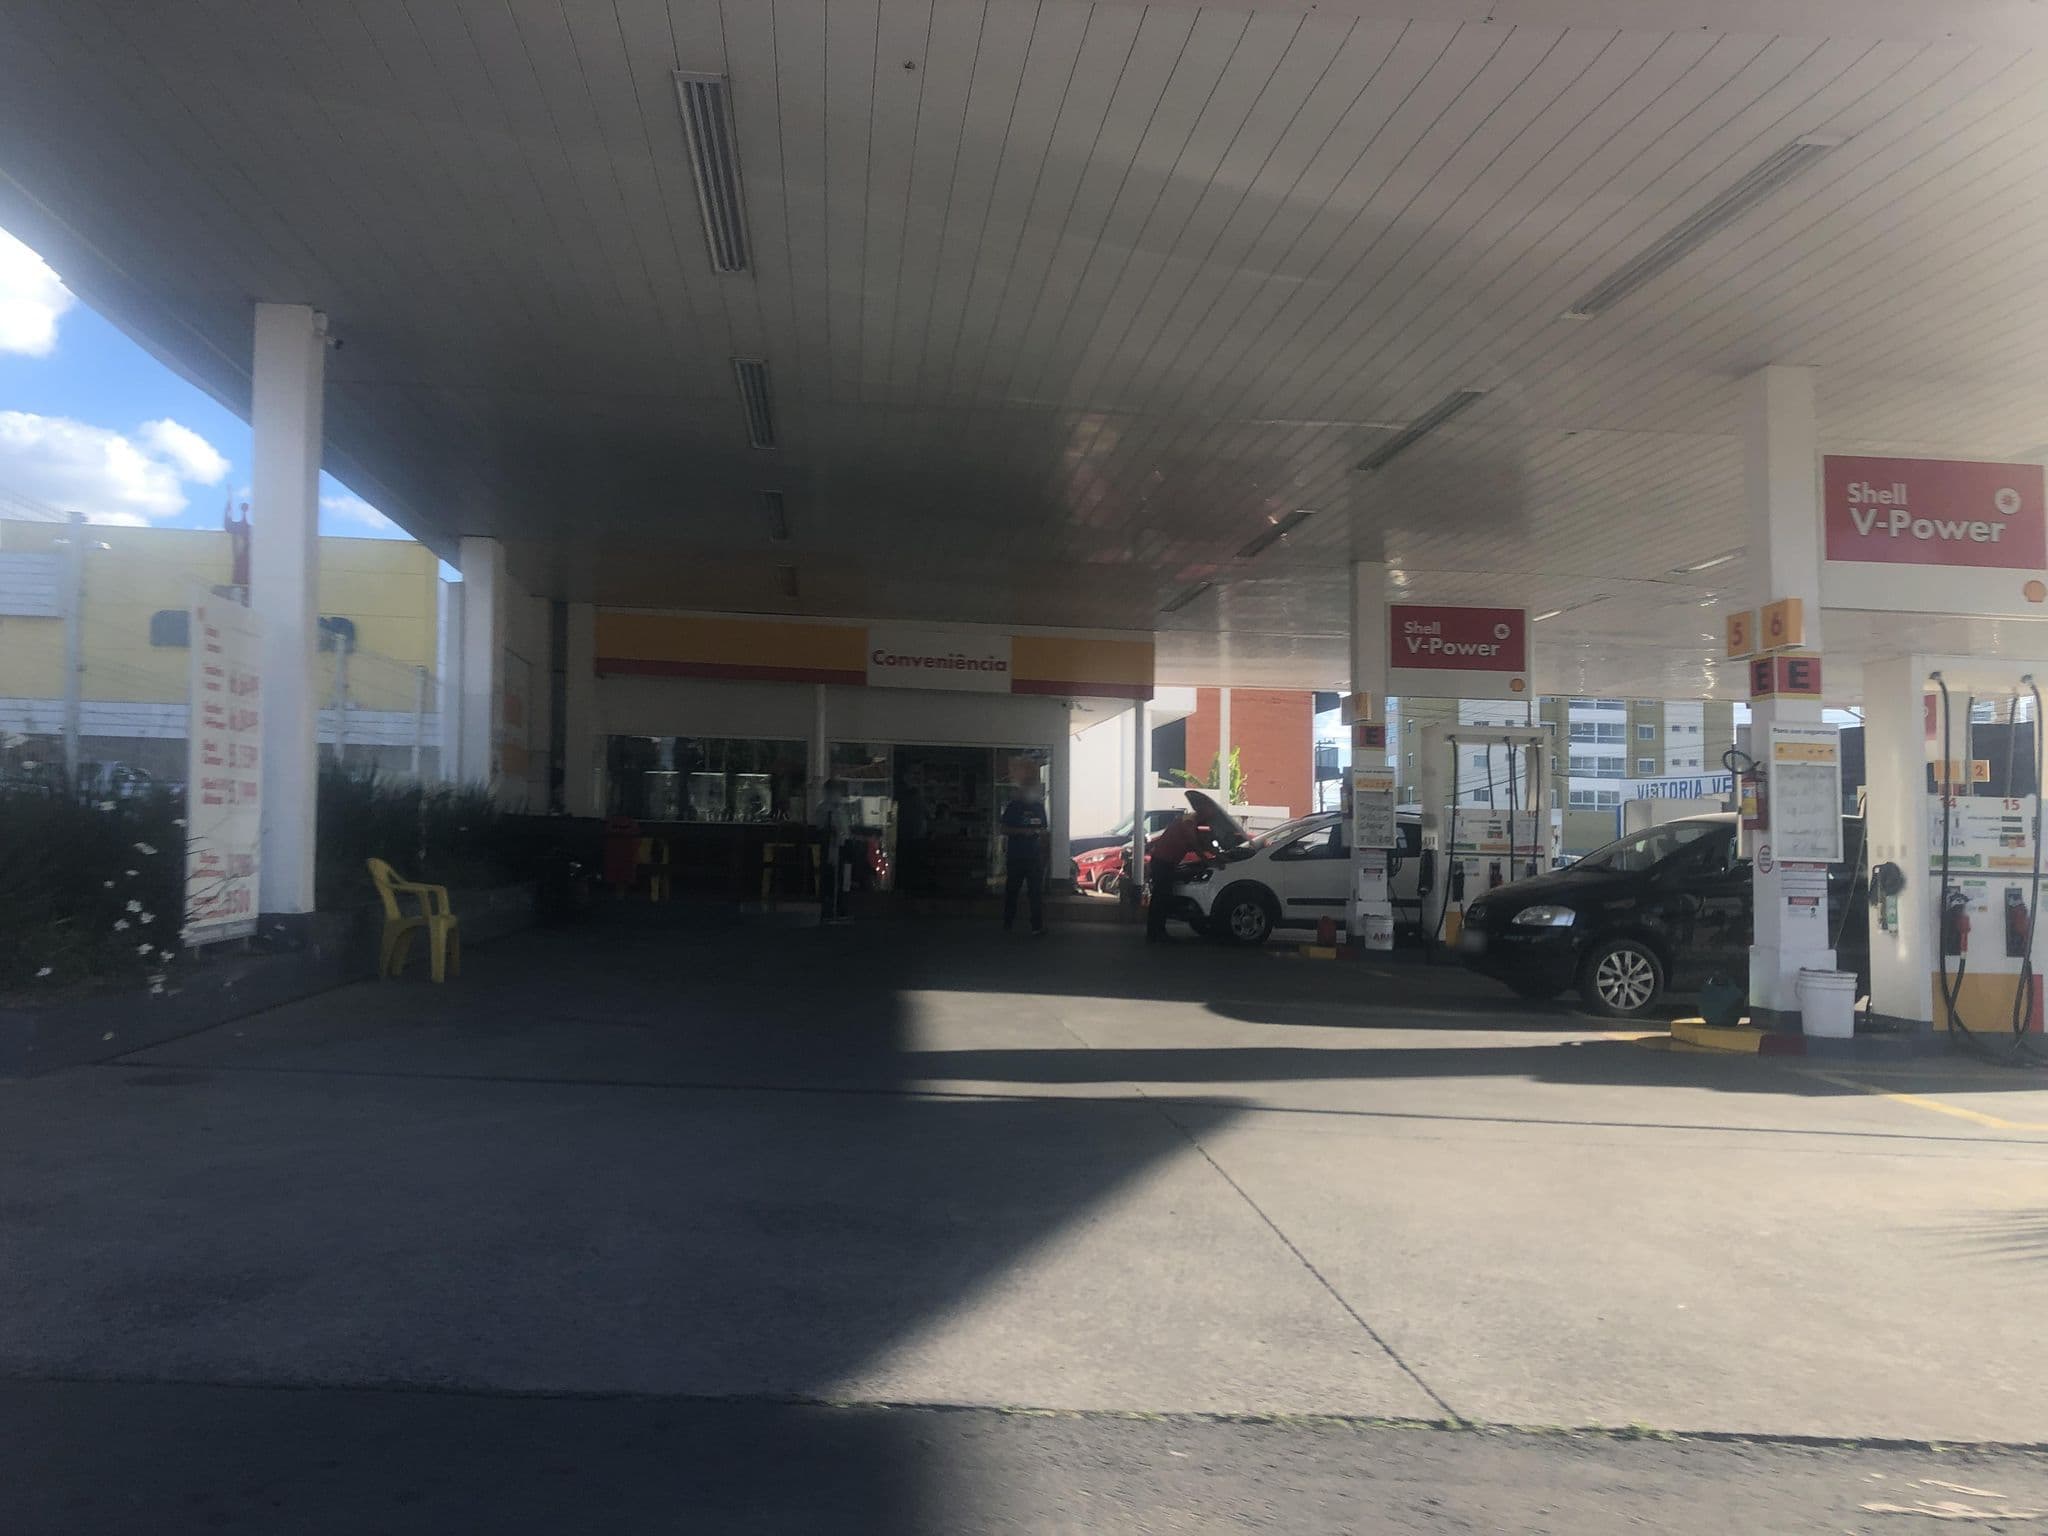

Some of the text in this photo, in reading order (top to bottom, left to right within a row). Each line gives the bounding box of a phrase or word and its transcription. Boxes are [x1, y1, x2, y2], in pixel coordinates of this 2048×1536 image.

[1847, 481, 1908, 506] Shell
[1849, 507, 2007, 544] V-Power
[1404, 620, 1441, 636] Shell
[1732, 621, 1744, 647] 5
[1406, 636, 1501, 657] V-Power
[872, 648, 1008, 673] Conveniência
[1788, 660, 1809, 689] E
[1975, 765, 1984, 777] 2
[2002, 799, 2021, 811] 15
